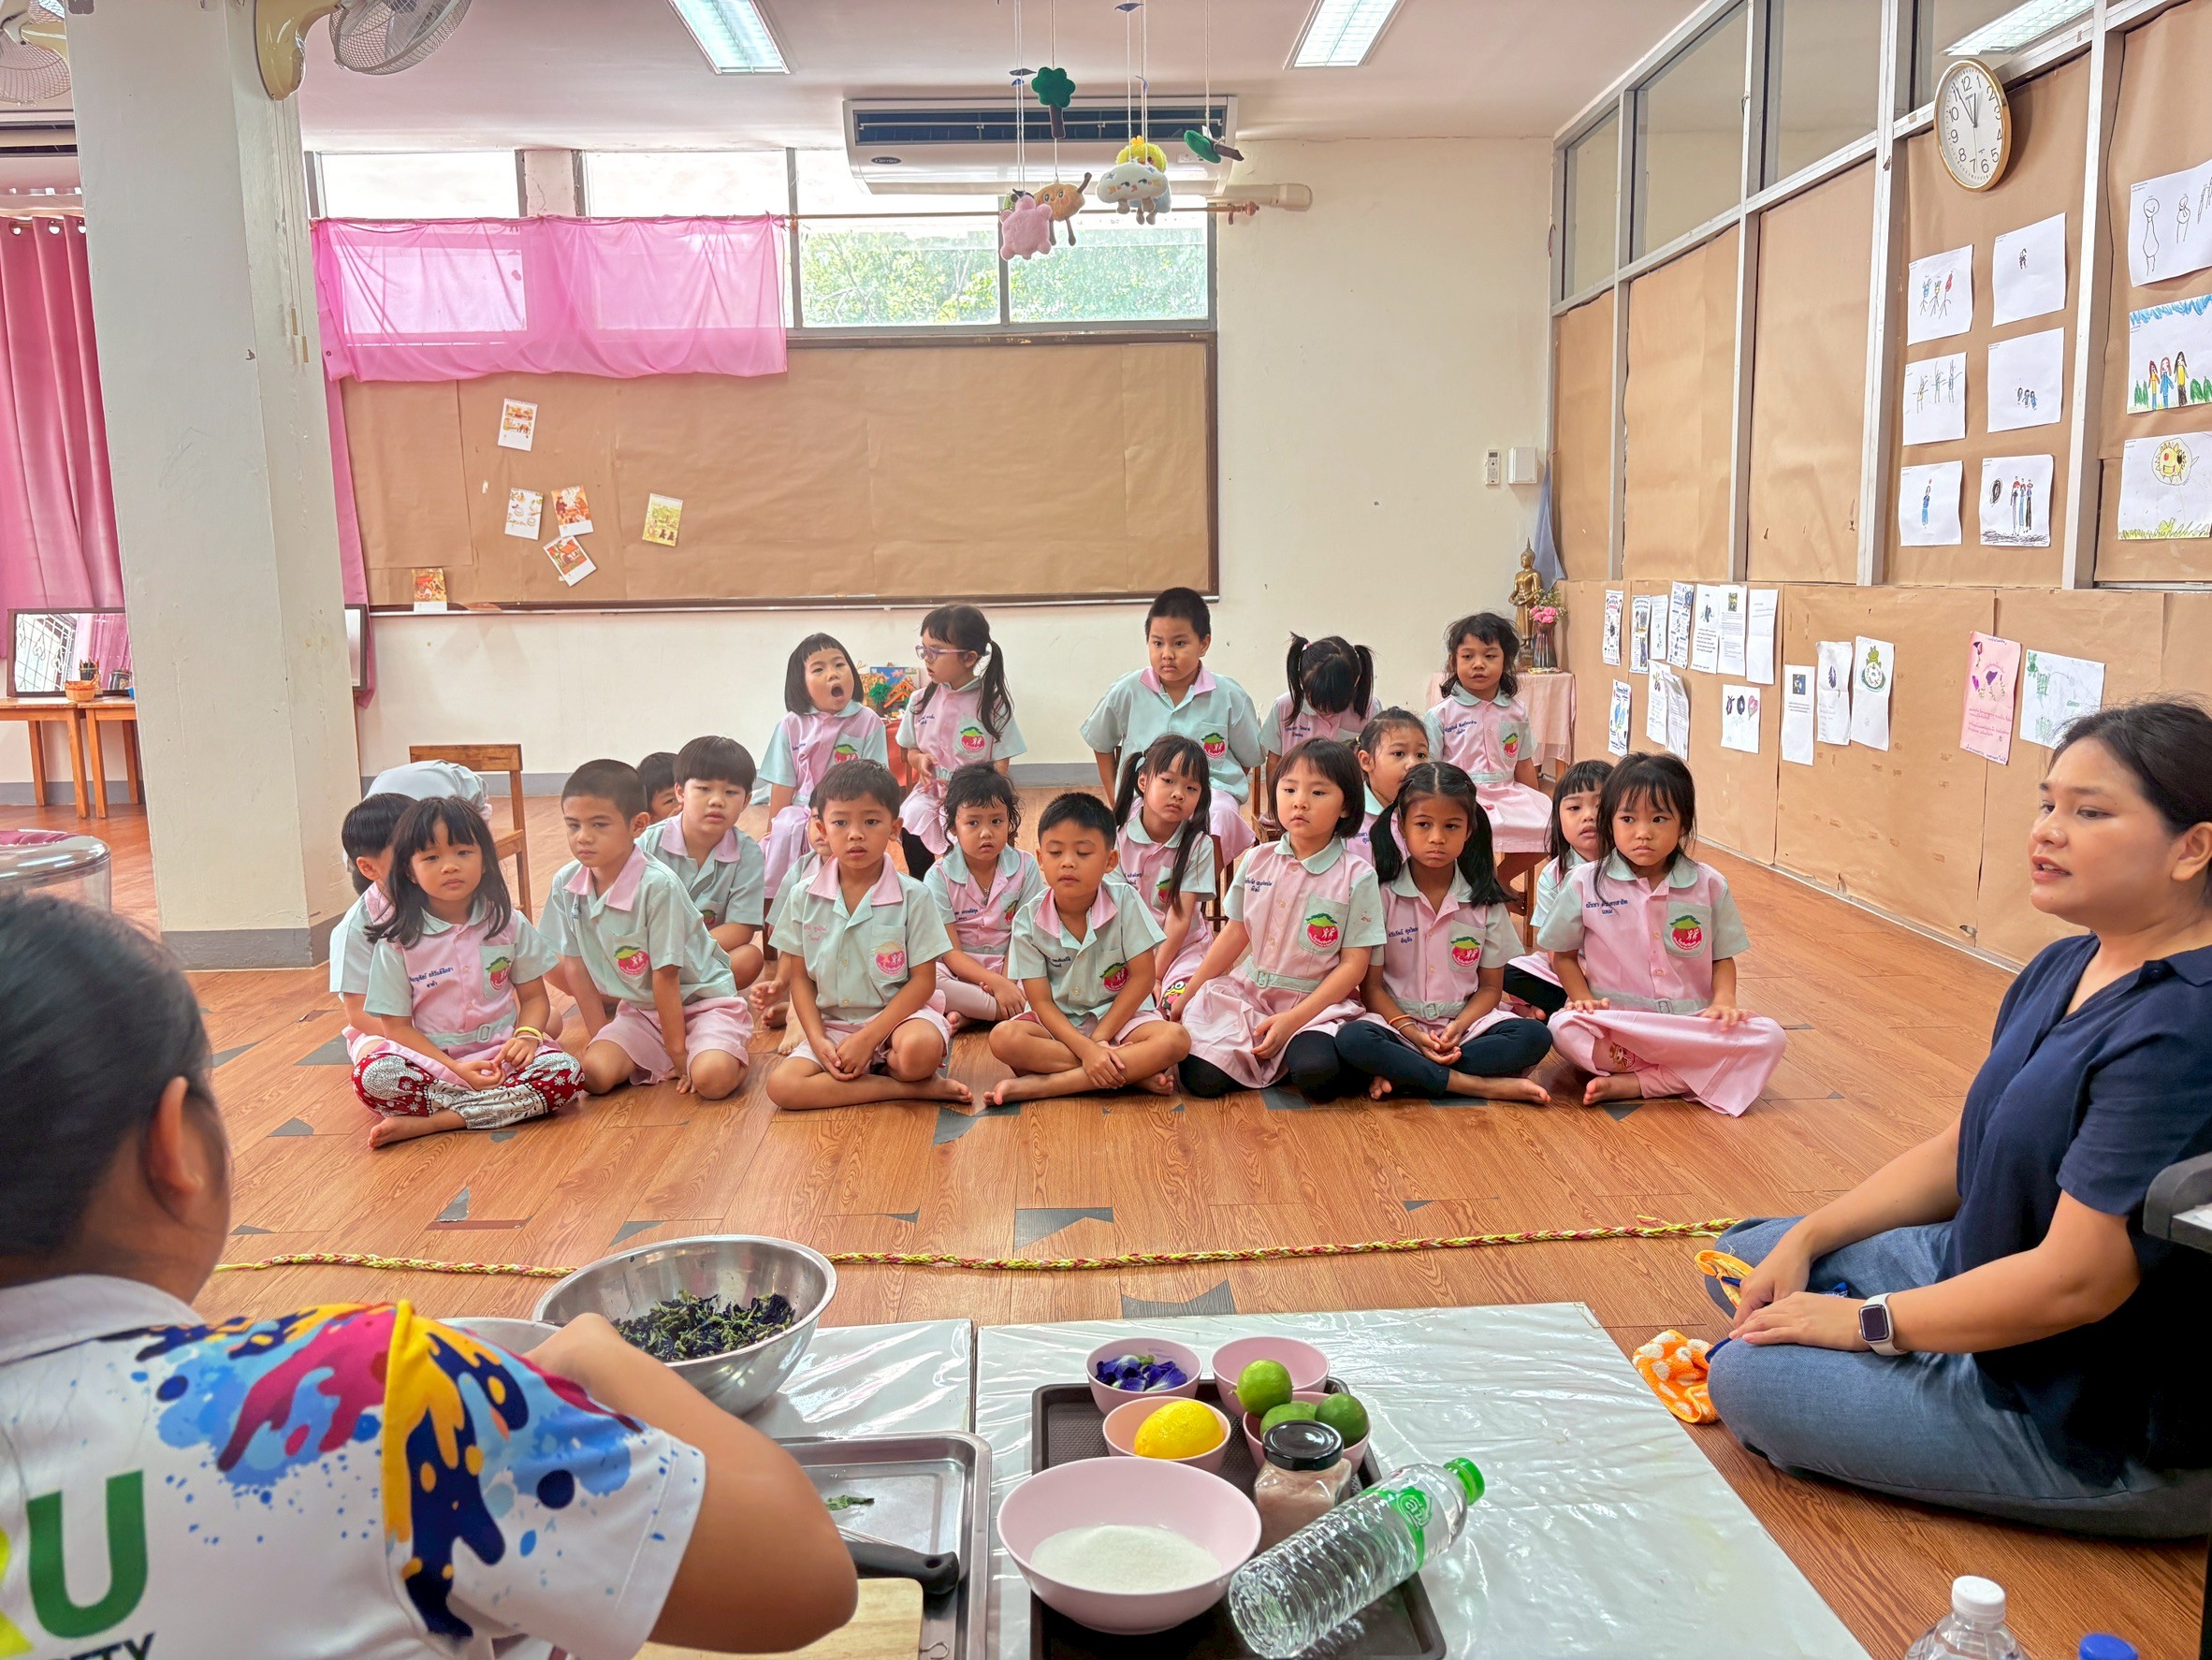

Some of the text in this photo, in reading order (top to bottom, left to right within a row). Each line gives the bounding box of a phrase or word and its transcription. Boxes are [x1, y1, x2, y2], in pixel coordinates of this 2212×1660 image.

[1961, 76, 1972, 92] 12
[1976, 75, 1982, 89] 1
[1986, 85, 1995, 101] 2
[1949, 107, 1959, 123] 10
[1994, 105, 2001, 121] 3
[1950, 129, 1958, 143] 9
[1997, 128, 2002, 140] 4
[1958, 148, 1967, 162] 8
[1990, 148, 2000, 163] 5
[1970, 159, 1976, 173] 7
[1981, 159, 1989, 173] 6
